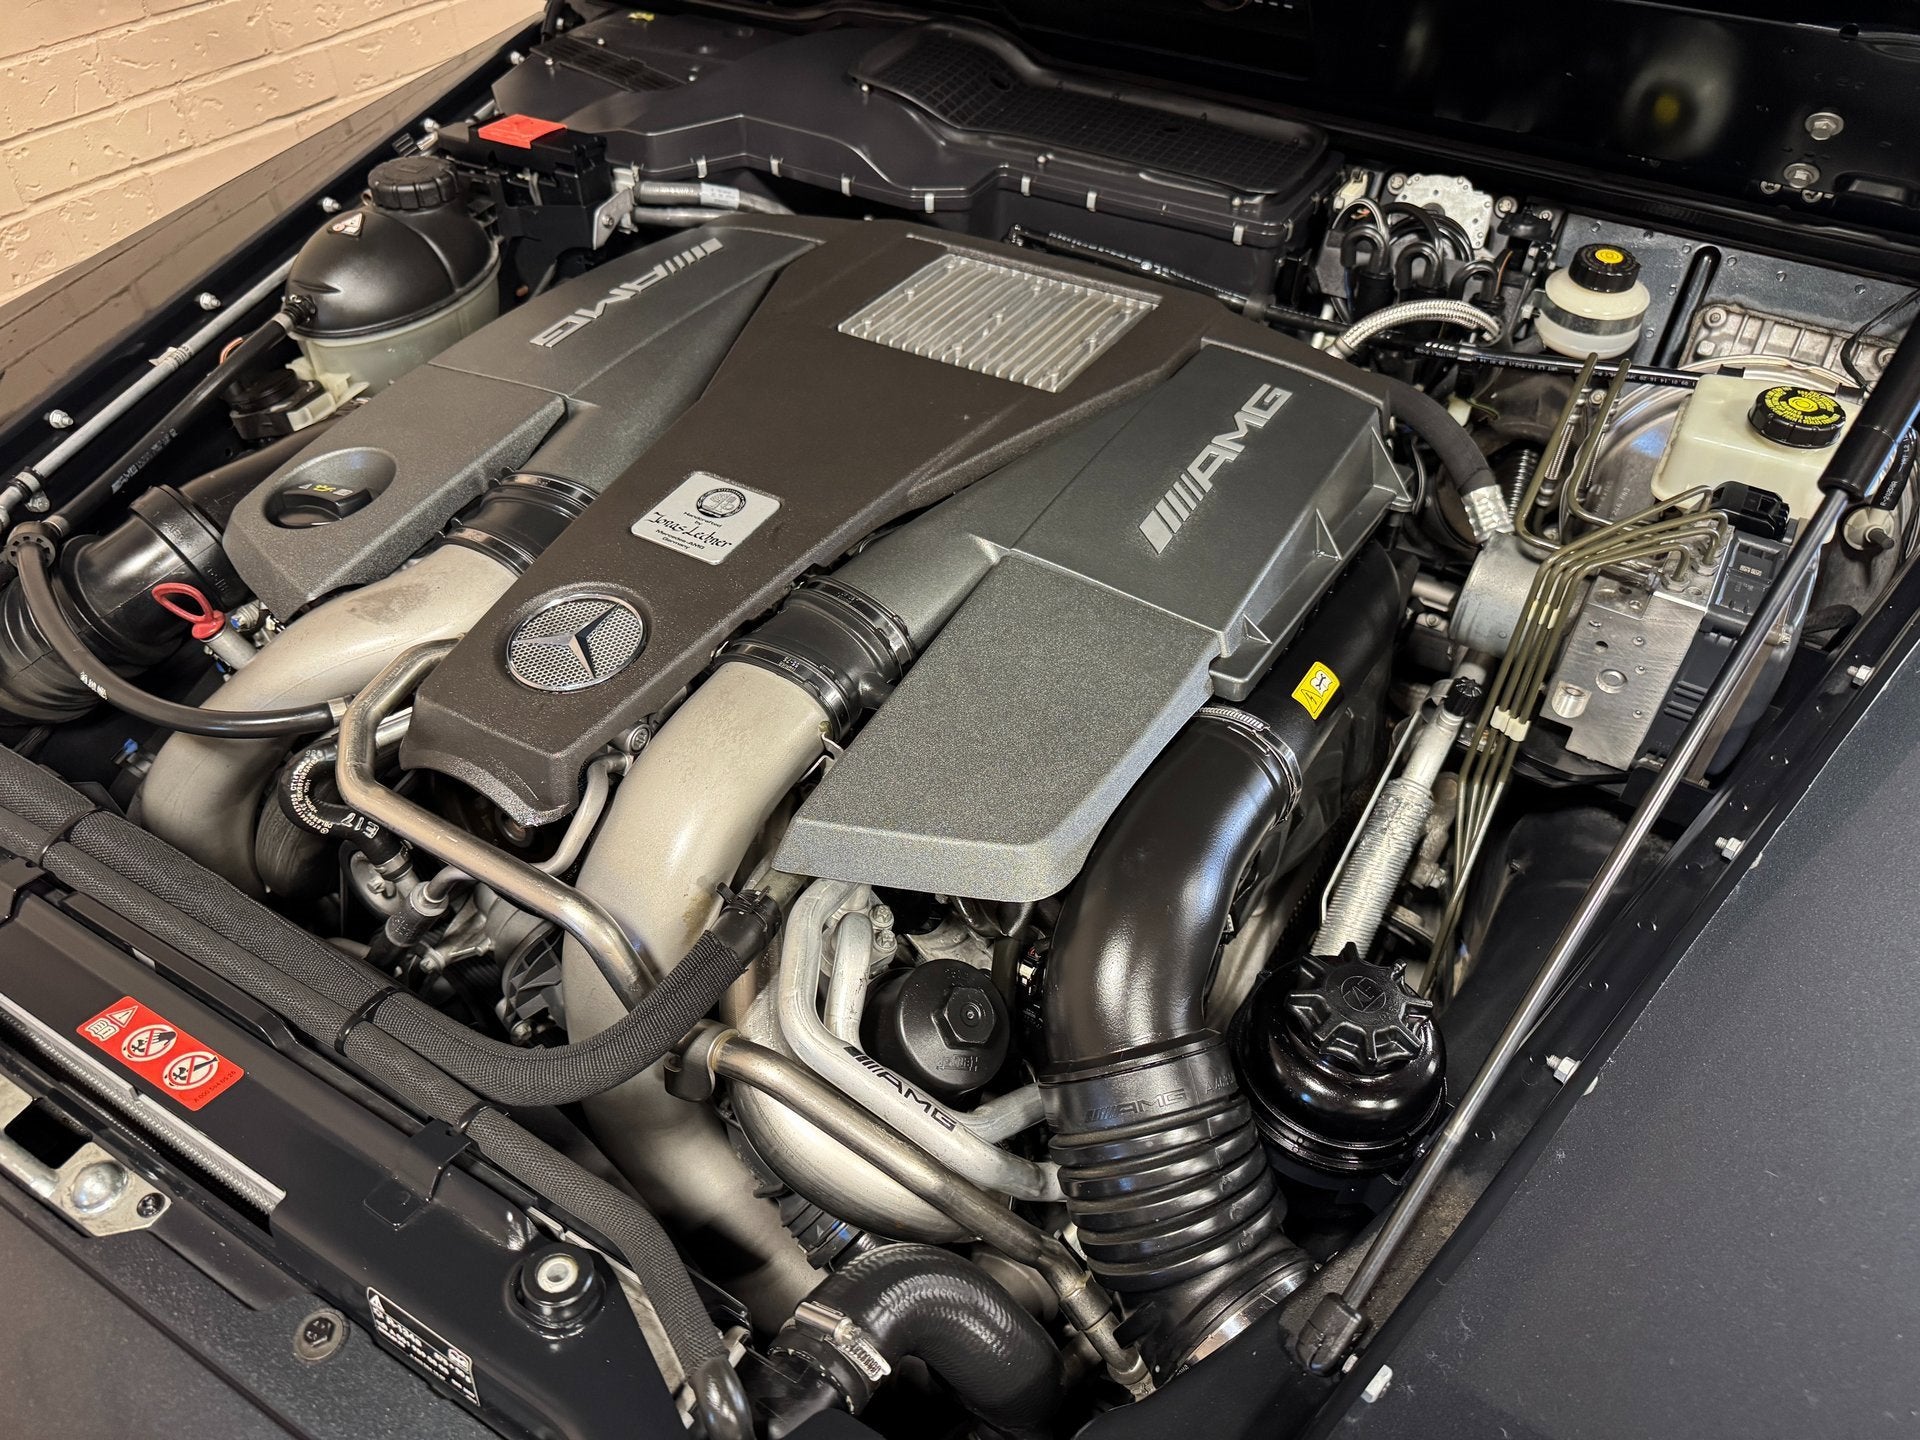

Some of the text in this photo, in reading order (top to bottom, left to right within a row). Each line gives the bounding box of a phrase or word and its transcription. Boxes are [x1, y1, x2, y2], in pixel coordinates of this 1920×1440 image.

[644, 511, 733, 548] Jonas Lechner
[341, 812, 380, 839] E17
[876, 1068, 958, 1132] AMG
[1116, 1088, 1187, 1115] AMG
